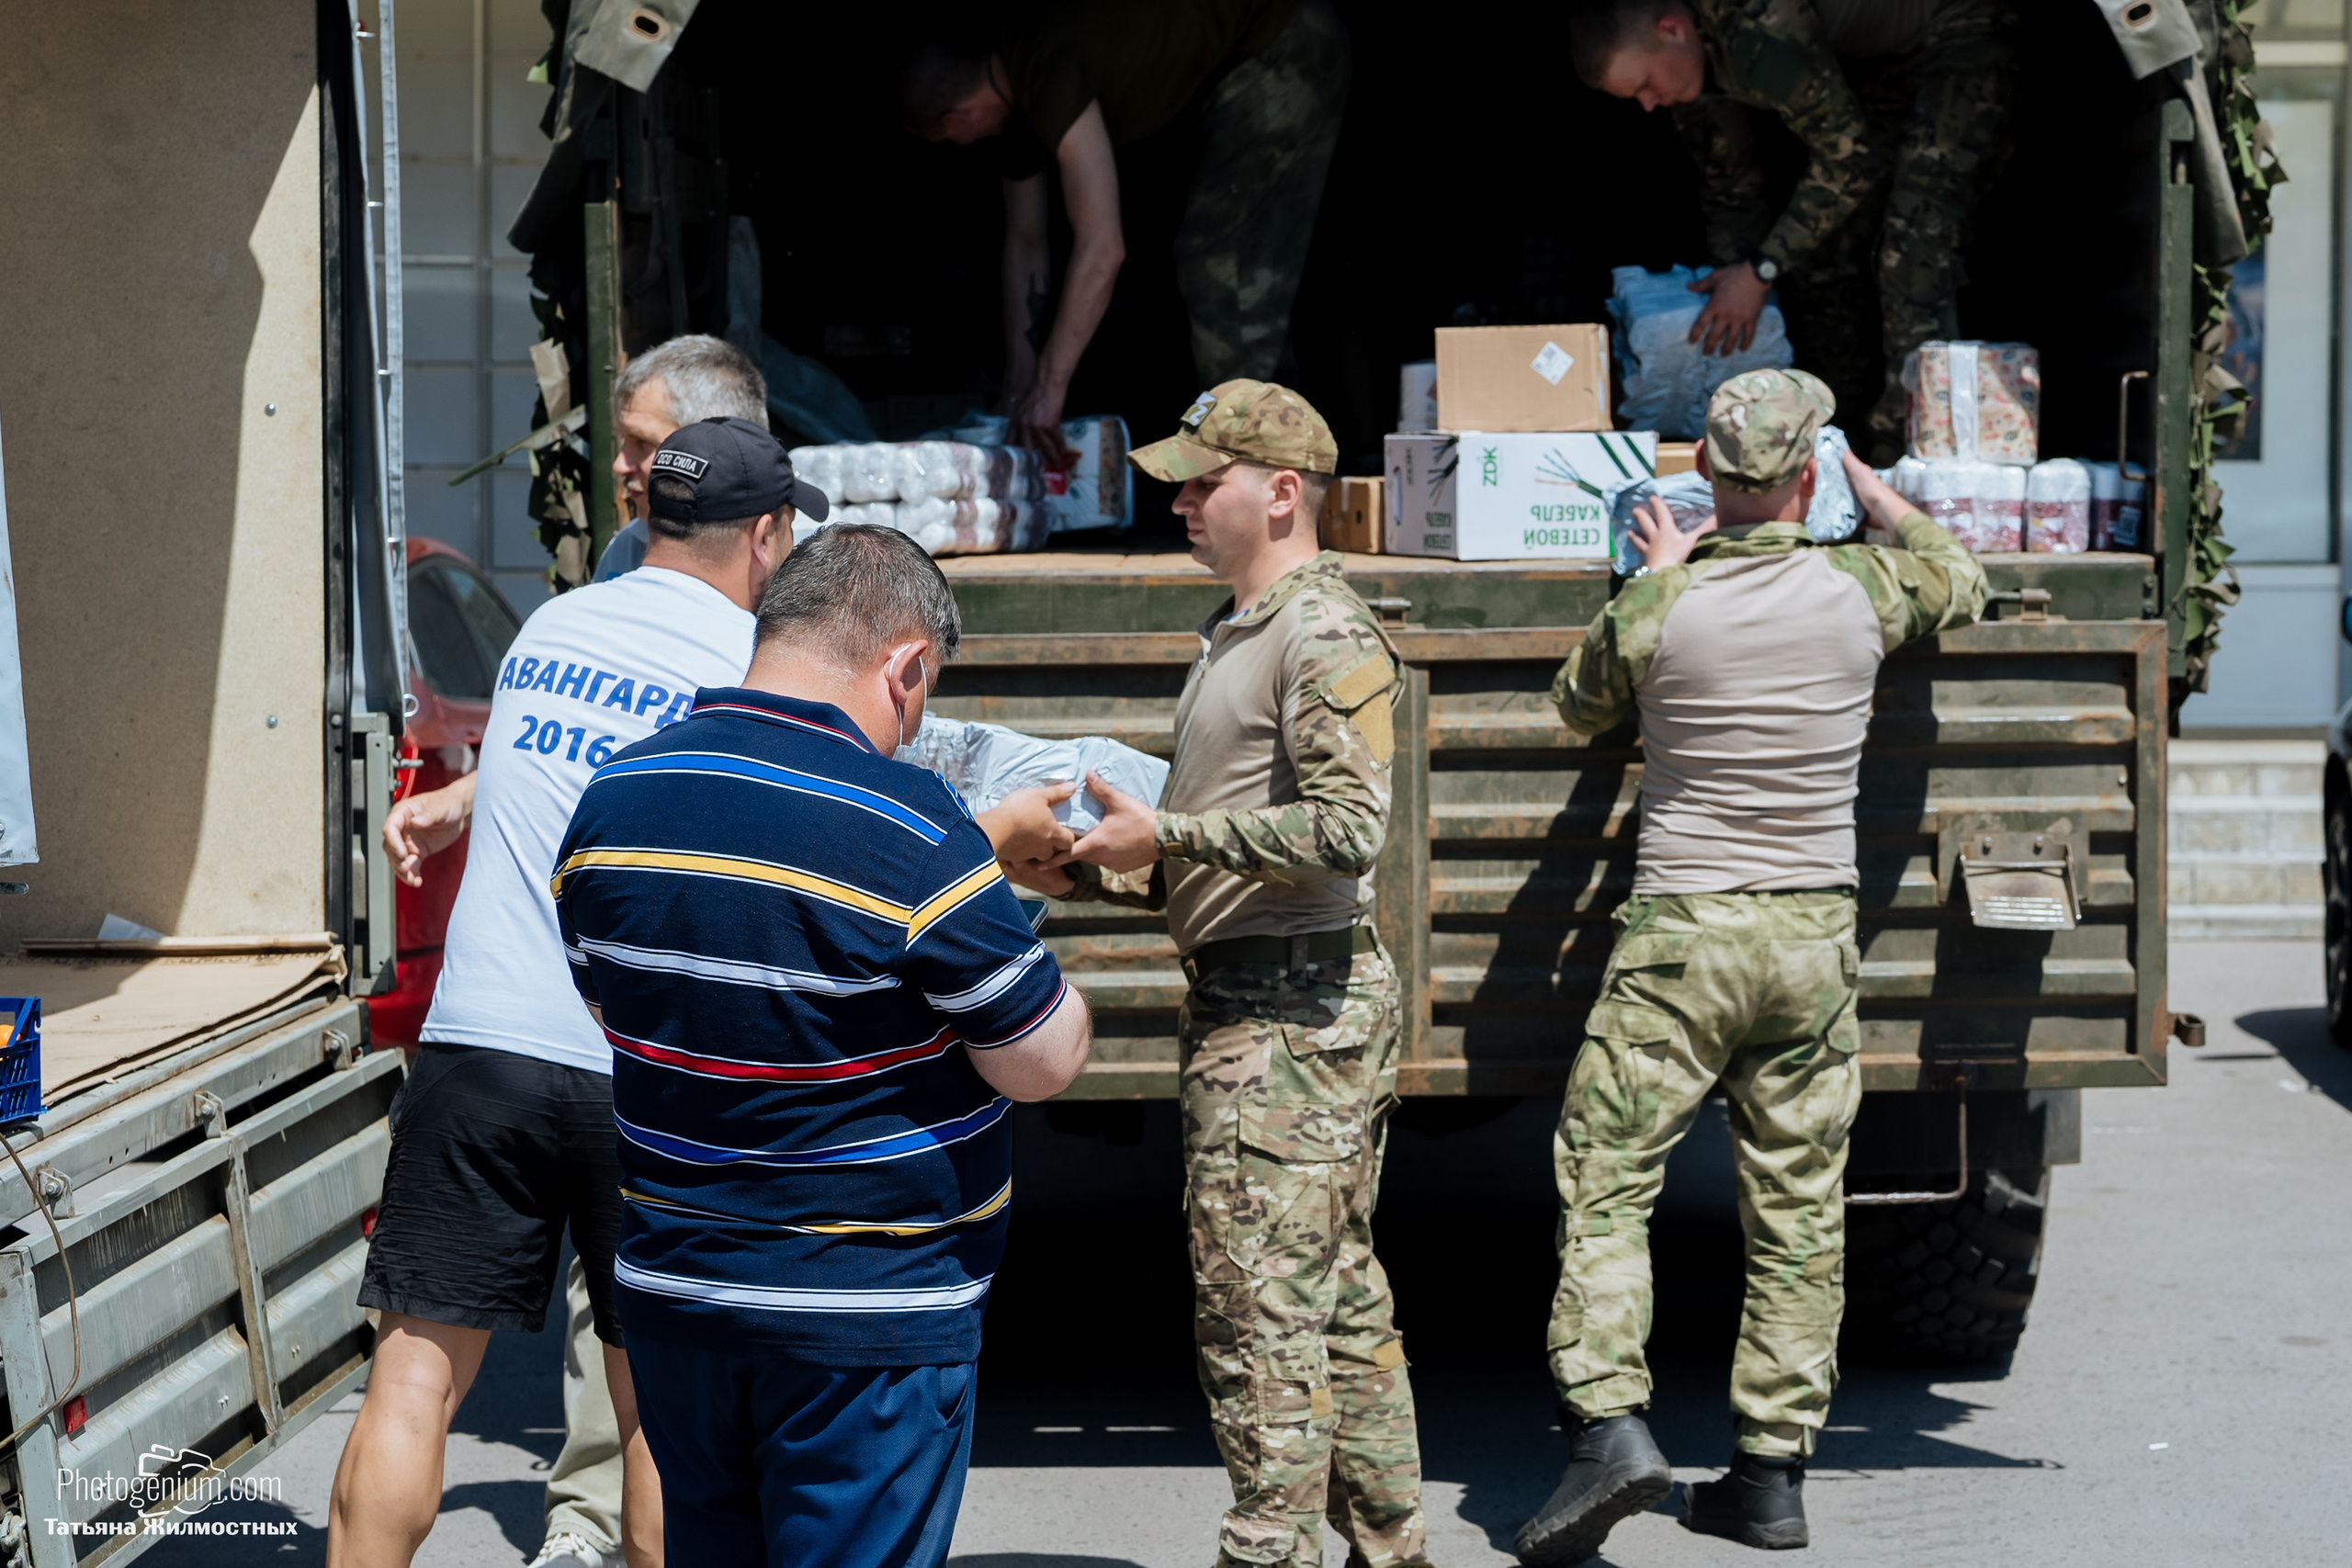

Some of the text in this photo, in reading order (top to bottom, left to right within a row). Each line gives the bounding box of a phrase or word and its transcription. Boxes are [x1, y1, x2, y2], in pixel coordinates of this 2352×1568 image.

[673, 456, 696, 472] СИЛА
[1482, 446, 1498, 487] ZDK
[1531, 504, 1600, 522] КАБЕЛЬ
[1523, 528, 1600, 550] СЕТЕВОЙ
[499, 656, 695, 729] АВАНГАРД
[513, 715, 616, 769] 2016
